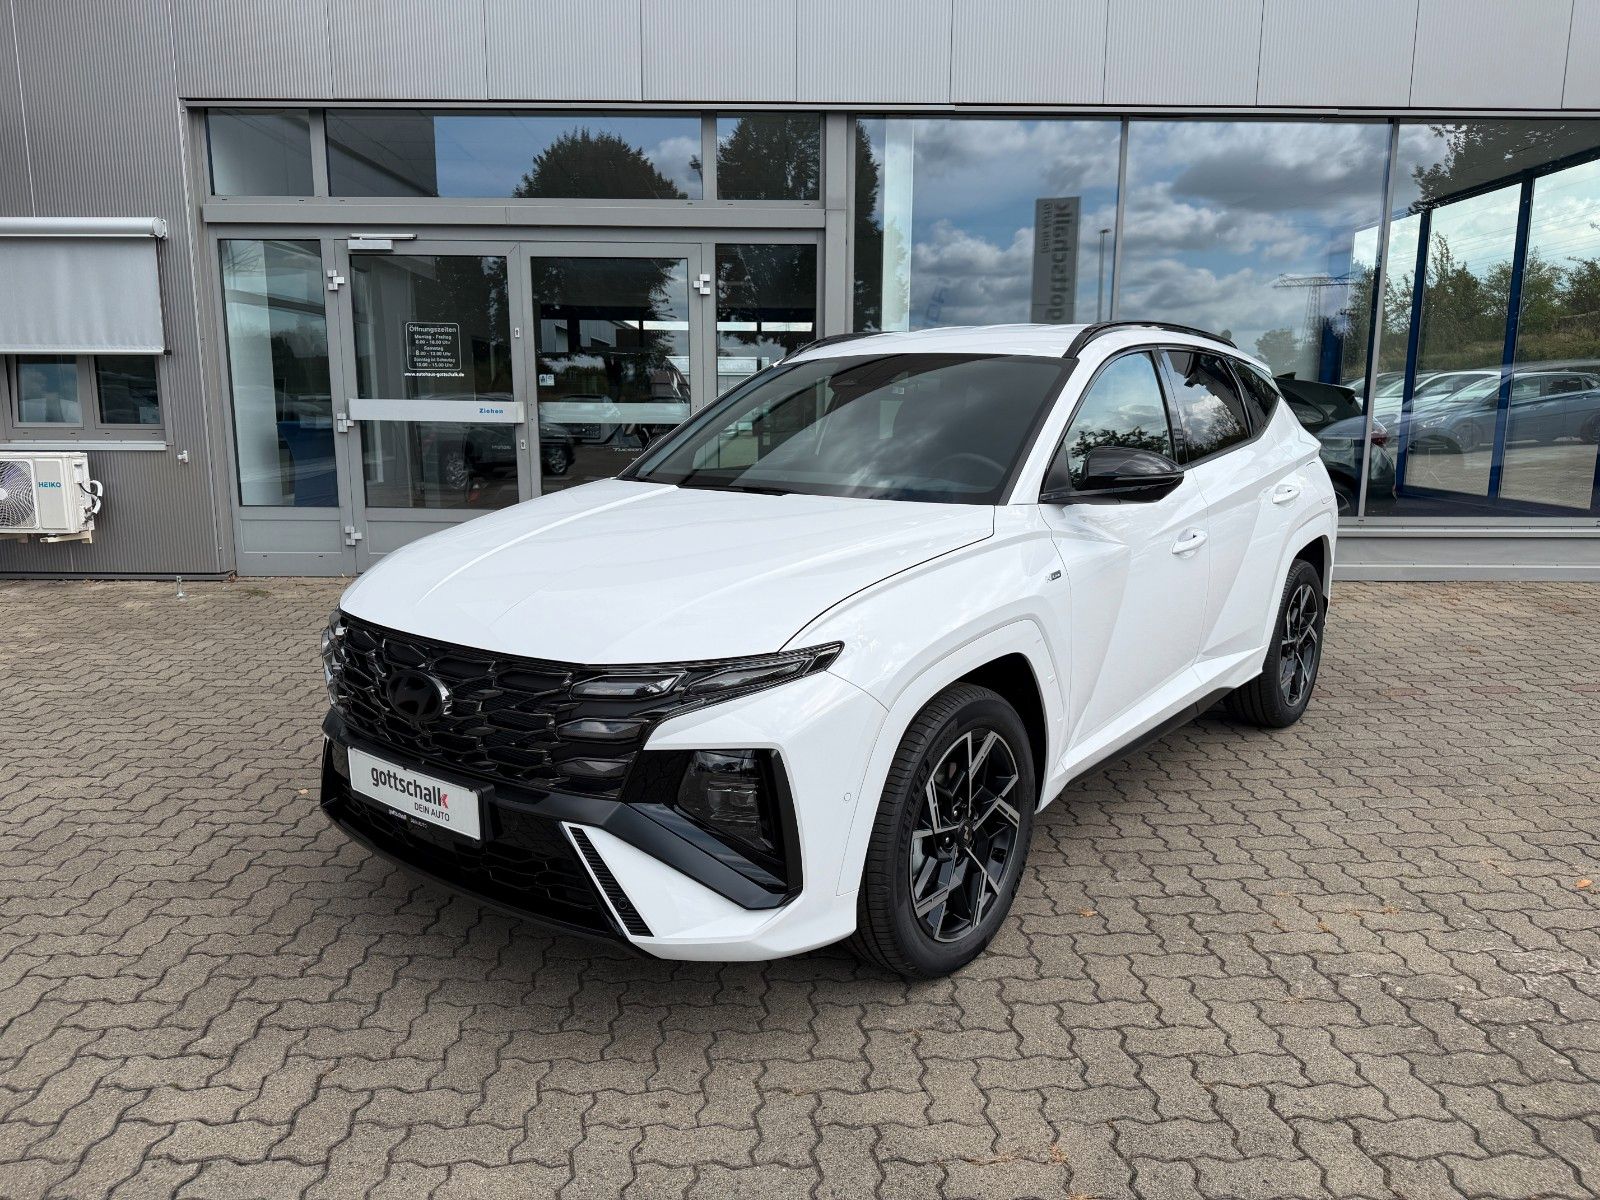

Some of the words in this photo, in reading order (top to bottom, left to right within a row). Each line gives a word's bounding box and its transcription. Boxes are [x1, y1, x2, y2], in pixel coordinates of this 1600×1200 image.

[409, 325, 457, 333] Öffnungszeiten
[371, 767, 449, 809] gottschalk
[414, 802, 430, 815] DEIN
[431, 808, 450, 821] AUTO
